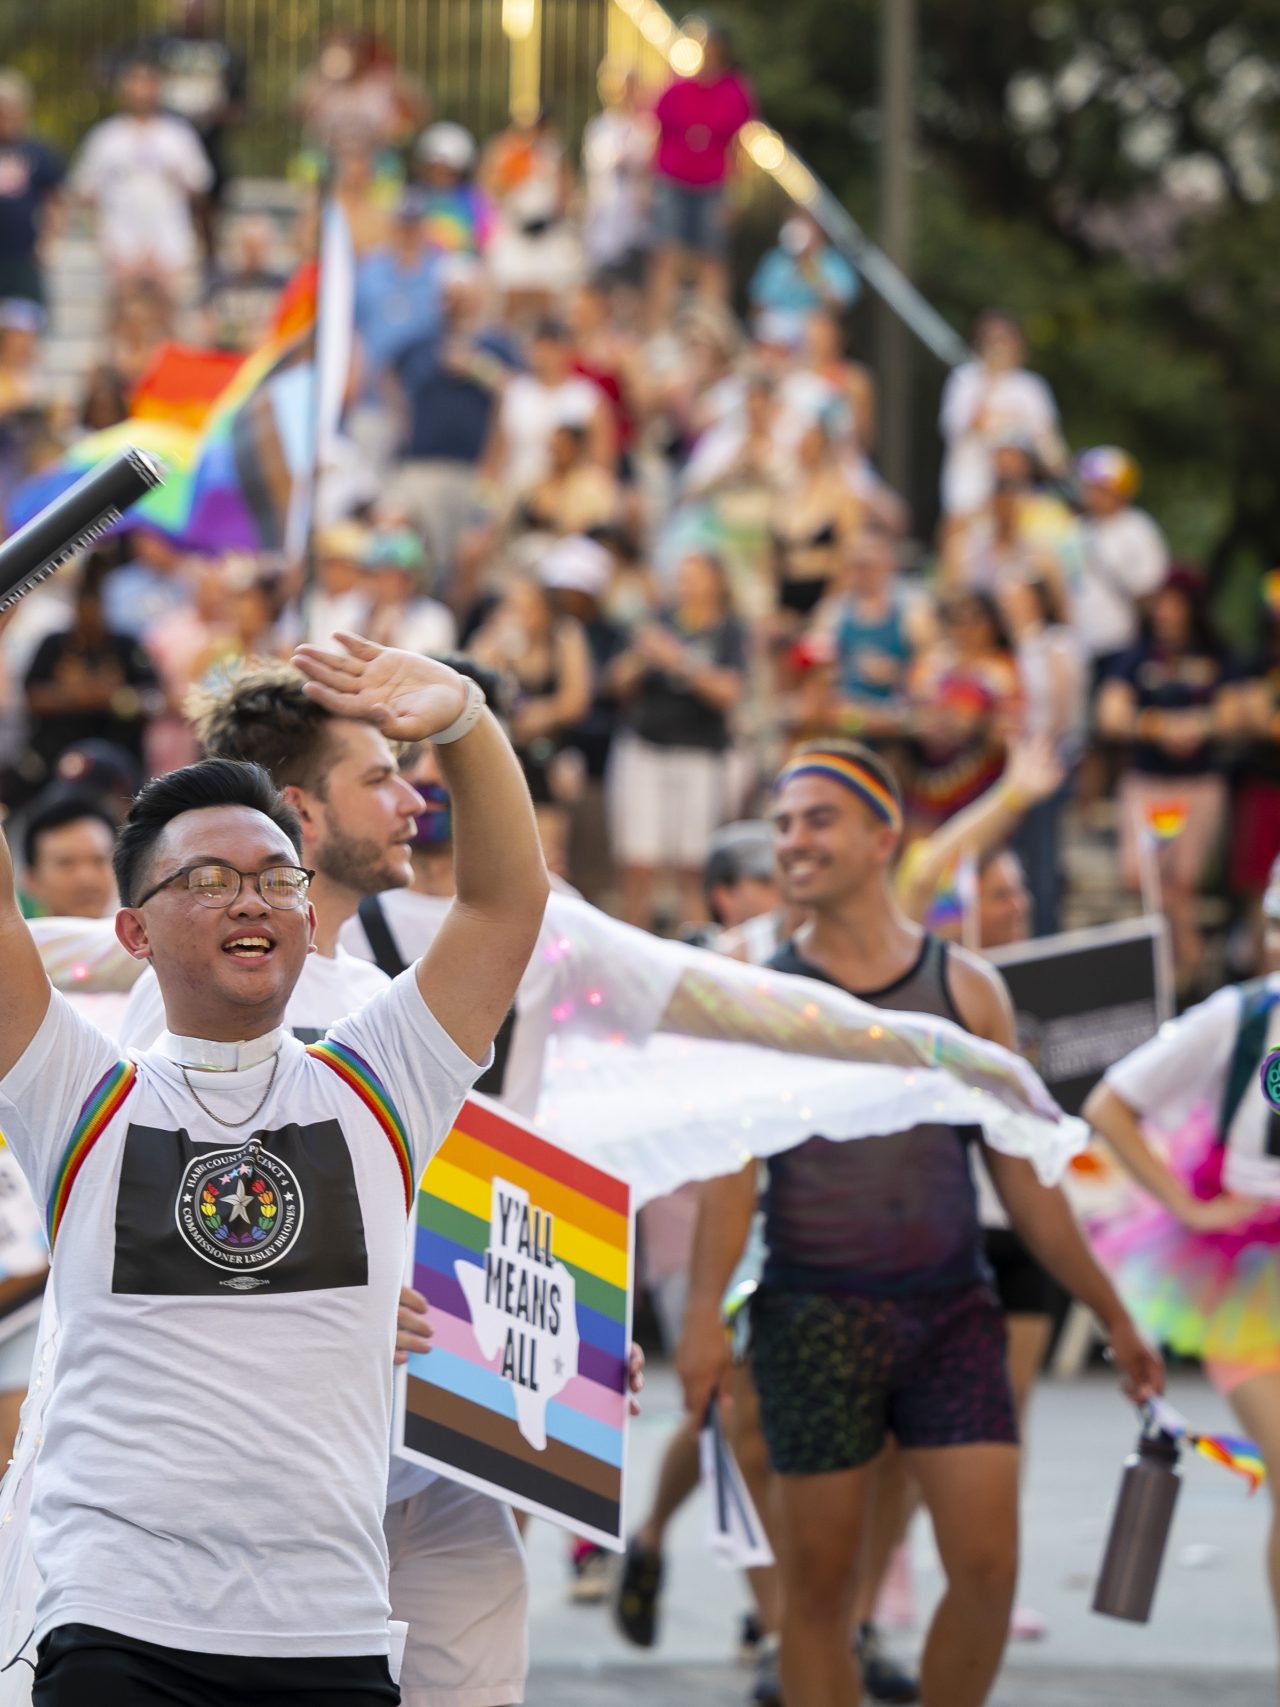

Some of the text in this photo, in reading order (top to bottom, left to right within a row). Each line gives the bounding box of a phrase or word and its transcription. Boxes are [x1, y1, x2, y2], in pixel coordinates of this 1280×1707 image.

[60, 508, 124, 562] CANNON
[182, 1204, 296, 1264] COMMISSIONER LESLEY BRIONES
[498, 1192, 554, 1269] Y'ALL
[485, 1252, 562, 1337] MEANS
[501, 1326, 539, 1392] ALL
